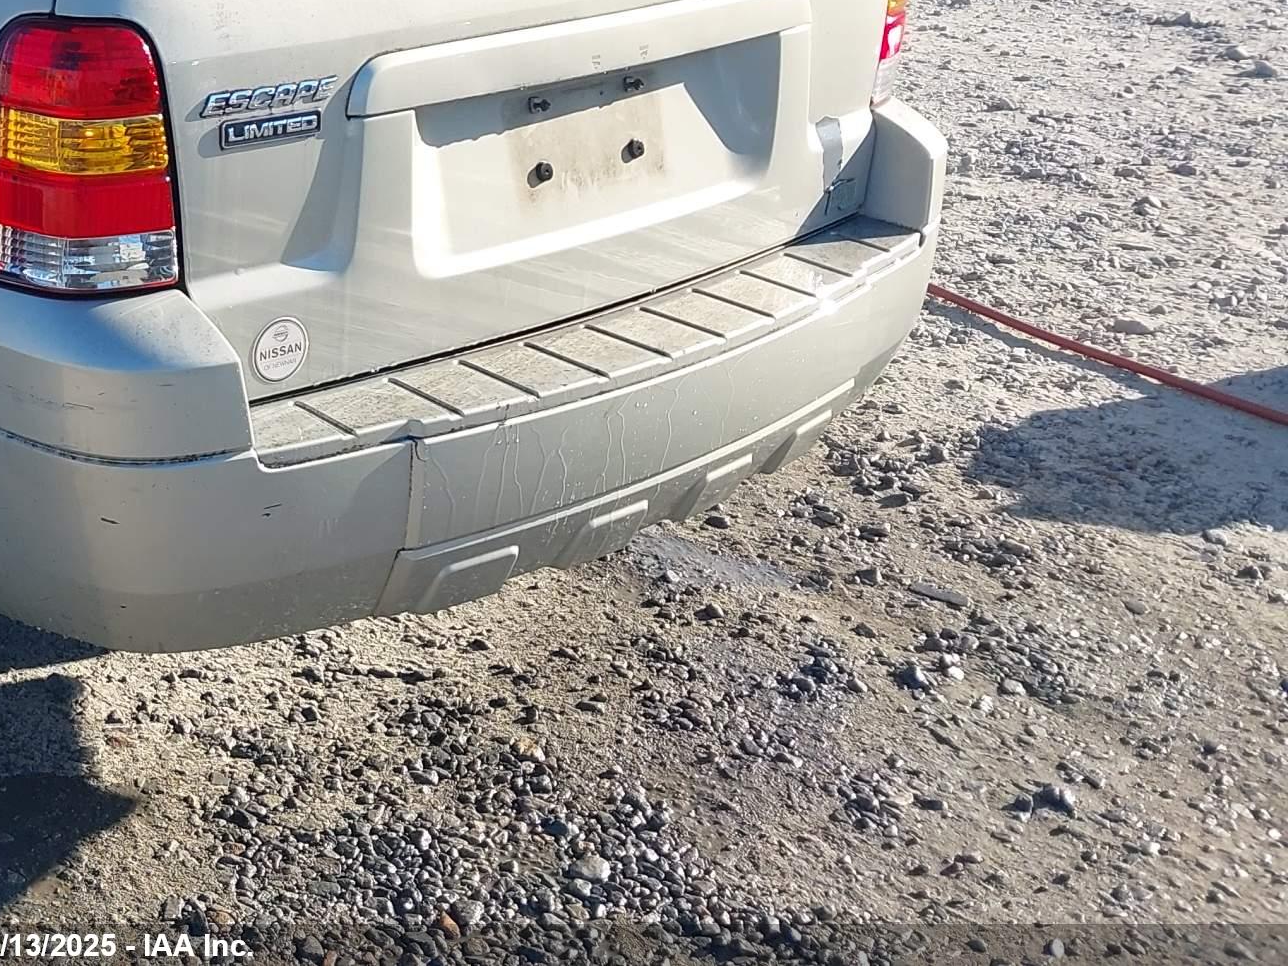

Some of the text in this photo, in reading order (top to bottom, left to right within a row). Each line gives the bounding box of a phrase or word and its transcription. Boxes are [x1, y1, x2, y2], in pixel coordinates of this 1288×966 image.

[200, 75, 338, 118] ESCAPE
[227, 114, 317, 141] LIMITED
[259, 341, 302, 362] NISSAN
